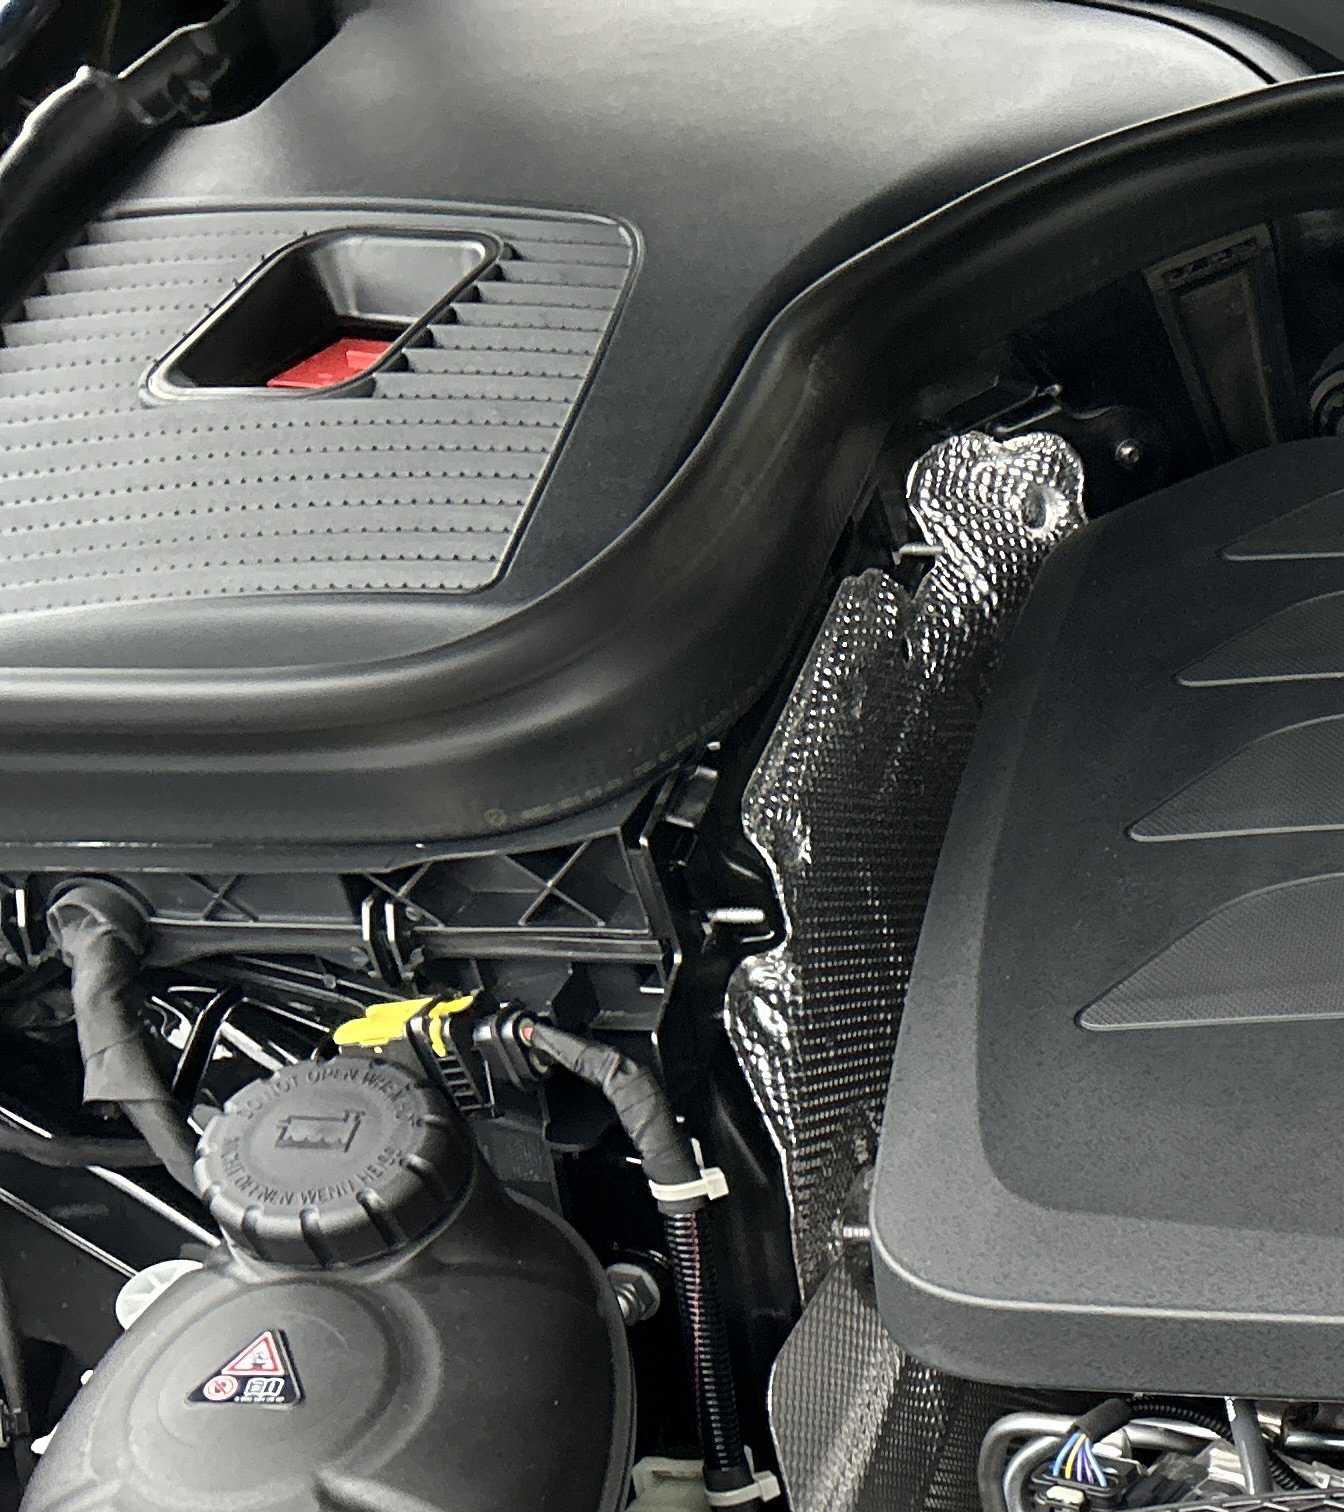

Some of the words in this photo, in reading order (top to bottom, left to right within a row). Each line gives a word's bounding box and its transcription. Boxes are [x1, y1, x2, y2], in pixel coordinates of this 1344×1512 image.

[262, 1075, 299, 1101] NOT
[306, 1067, 360, 1084] OPEN
[299, 1179, 357, 1205] WENN
